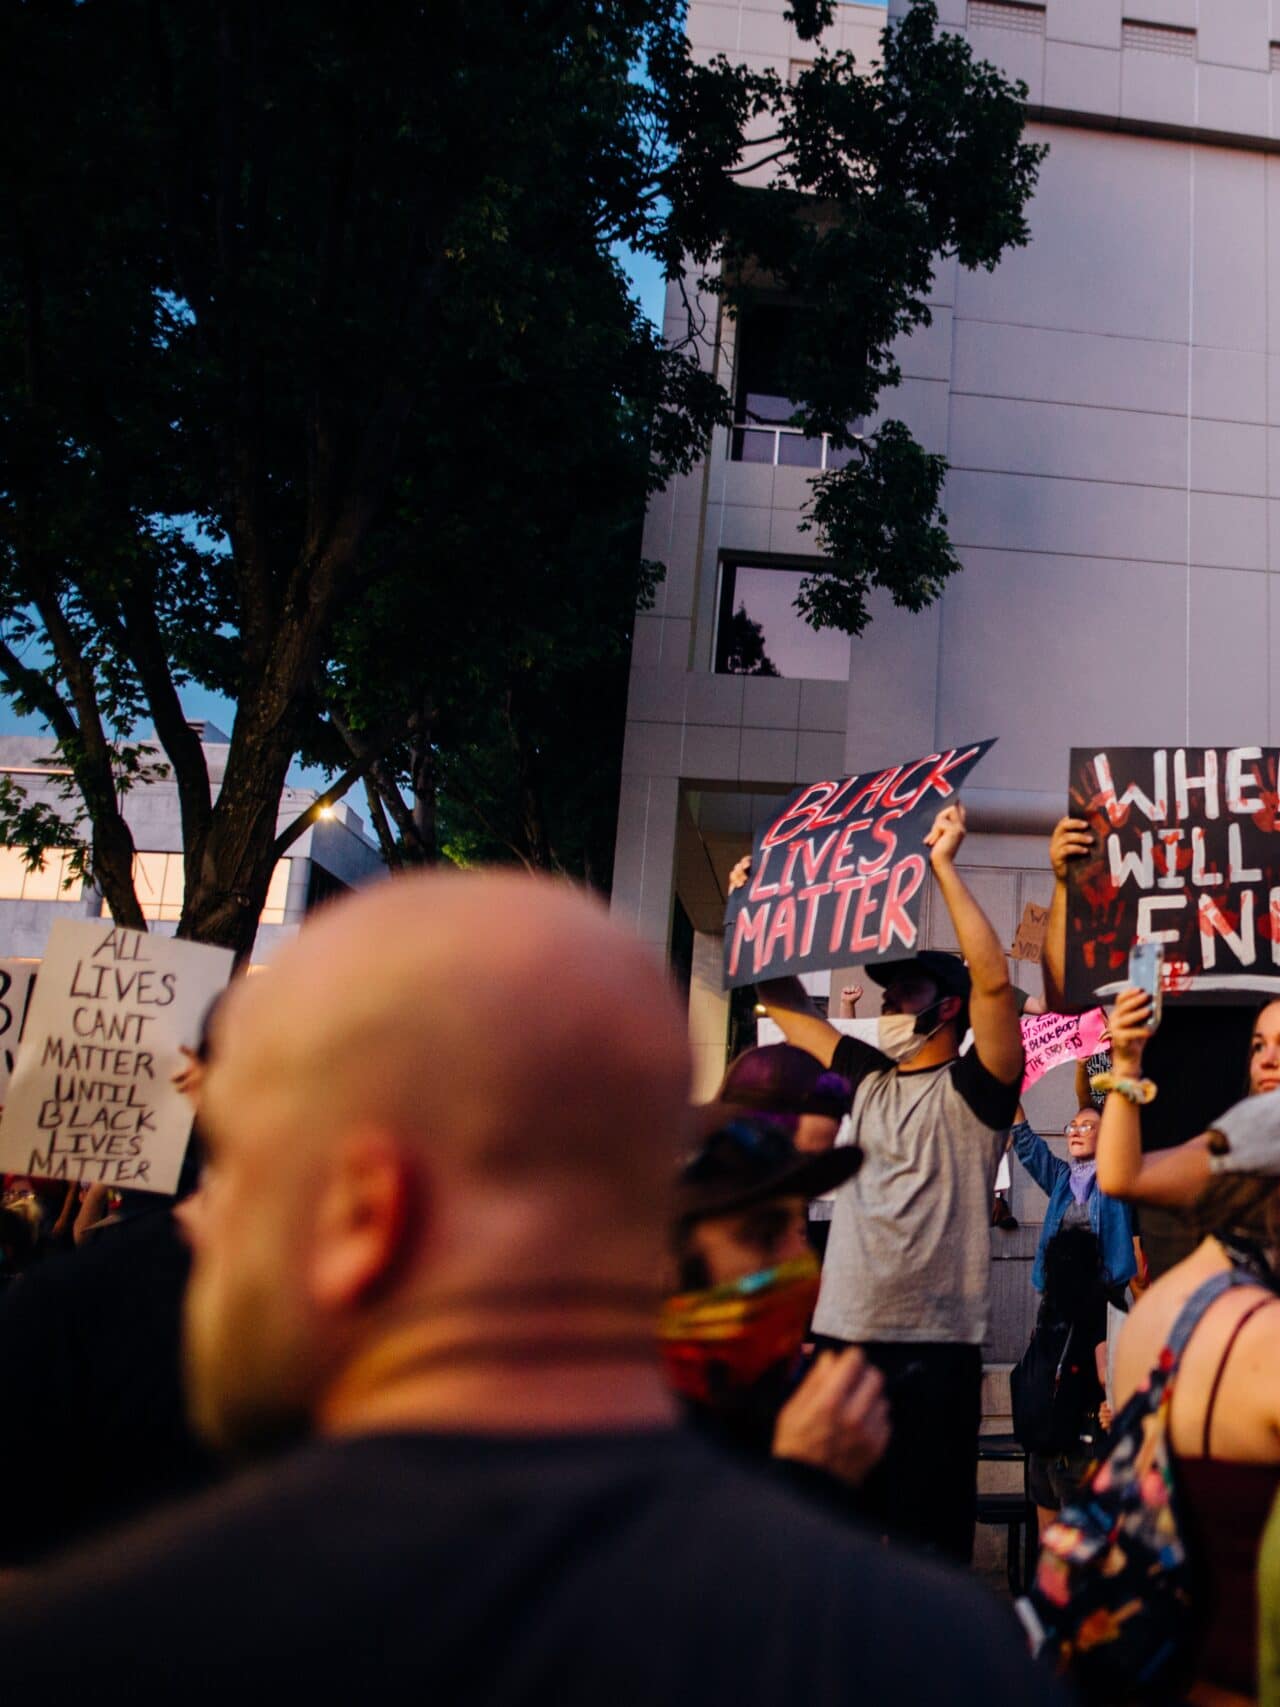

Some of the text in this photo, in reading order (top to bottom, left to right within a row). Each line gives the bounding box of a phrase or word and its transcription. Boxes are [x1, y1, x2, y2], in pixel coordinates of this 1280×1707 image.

[761, 746, 980, 849] BLACK
[749, 809, 902, 902] LIVES
[1106, 822, 1263, 890] WILL
[729, 853, 926, 977] MATTER
[91, 927, 153, 963] ALL
[69, 959, 177, 1006] LIVES
[72, 1005, 156, 1044] CANT
[1028, 1031, 1055, 1052] BLACK
[1055, 1014, 1082, 1038] BODY
[40, 1035, 155, 1080] MATTER
[1026, 1054, 1045, 1071] THE
[53, 1073, 149, 1109] UNTIL
[37, 1099, 157, 1132] BLACK
[49, 1128, 145, 1156] LIVES
[27, 1148, 152, 1183] MATTER
